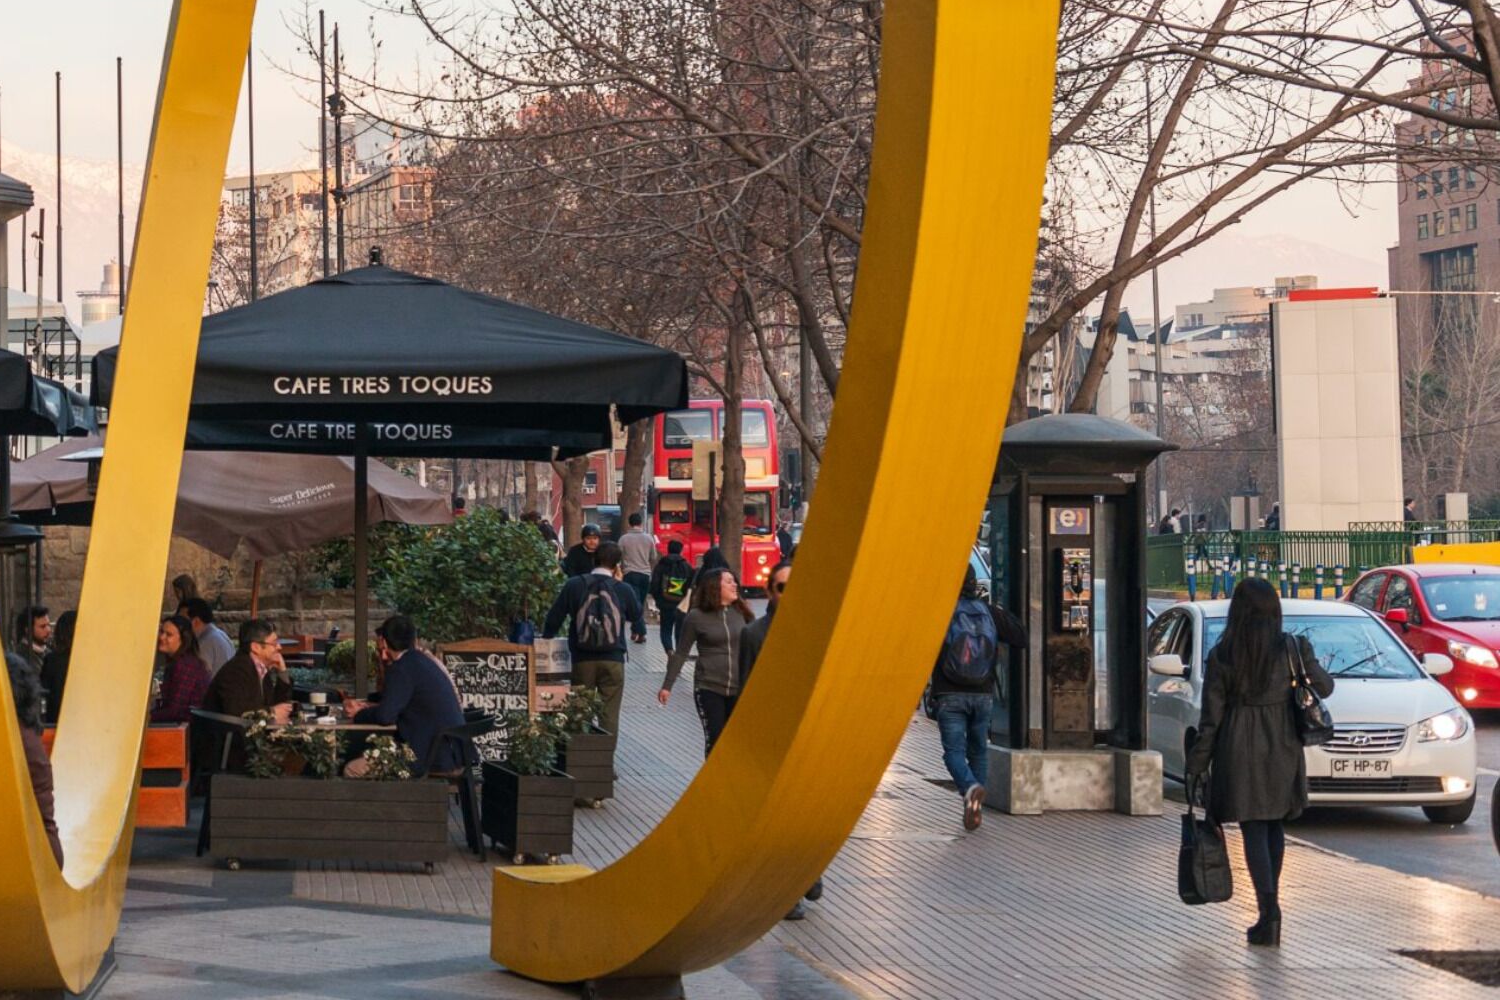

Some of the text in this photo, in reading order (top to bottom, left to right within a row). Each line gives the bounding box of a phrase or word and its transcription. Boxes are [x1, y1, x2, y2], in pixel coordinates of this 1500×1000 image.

[273, 376, 493, 396] CAFE TRES TOQUES
[269, 423, 453, 441] CAFE TRE TOQUES
[461, 692, 528, 710] POSTRES
